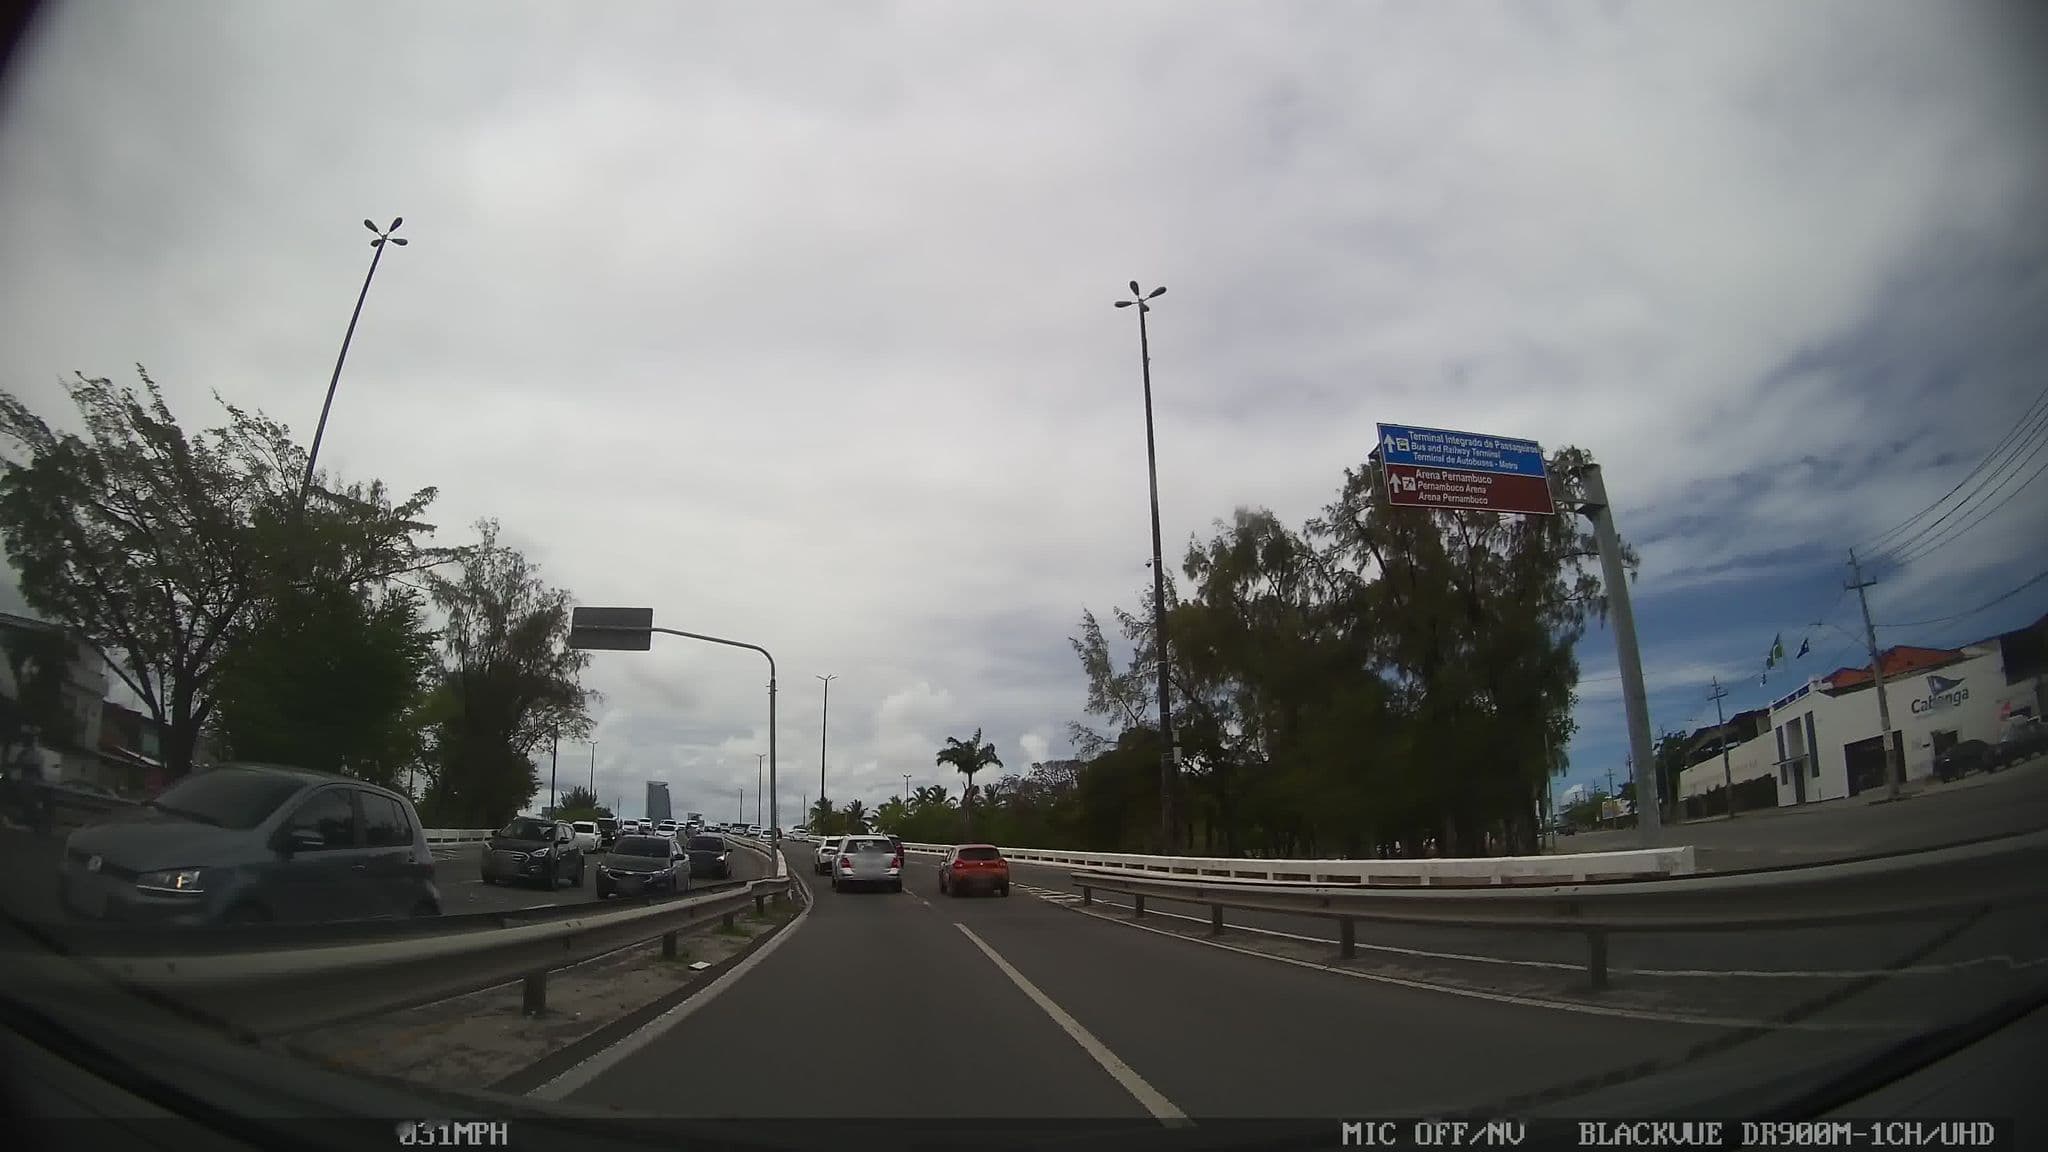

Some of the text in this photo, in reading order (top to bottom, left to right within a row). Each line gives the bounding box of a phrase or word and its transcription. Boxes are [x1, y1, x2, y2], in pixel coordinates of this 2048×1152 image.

[1409, 431, 1444, 443] Terminal
[1445, 434, 1482, 447] Integrado
[1484, 440, 1493, 448] de
[1411, 442, 1500, 459] Bus and Railway Terminal
[1413, 452, 1445, 462] Terminal
[1446, 455, 1456, 463] de
[1456, 456, 1494, 467] Autobuses
[1416, 469, 1492, 484] Arena Pernambuco
[1418, 481, 1487, 494] Pernambuco Arena
[1418, 492, 1488, 504] Arena Pernambuco
